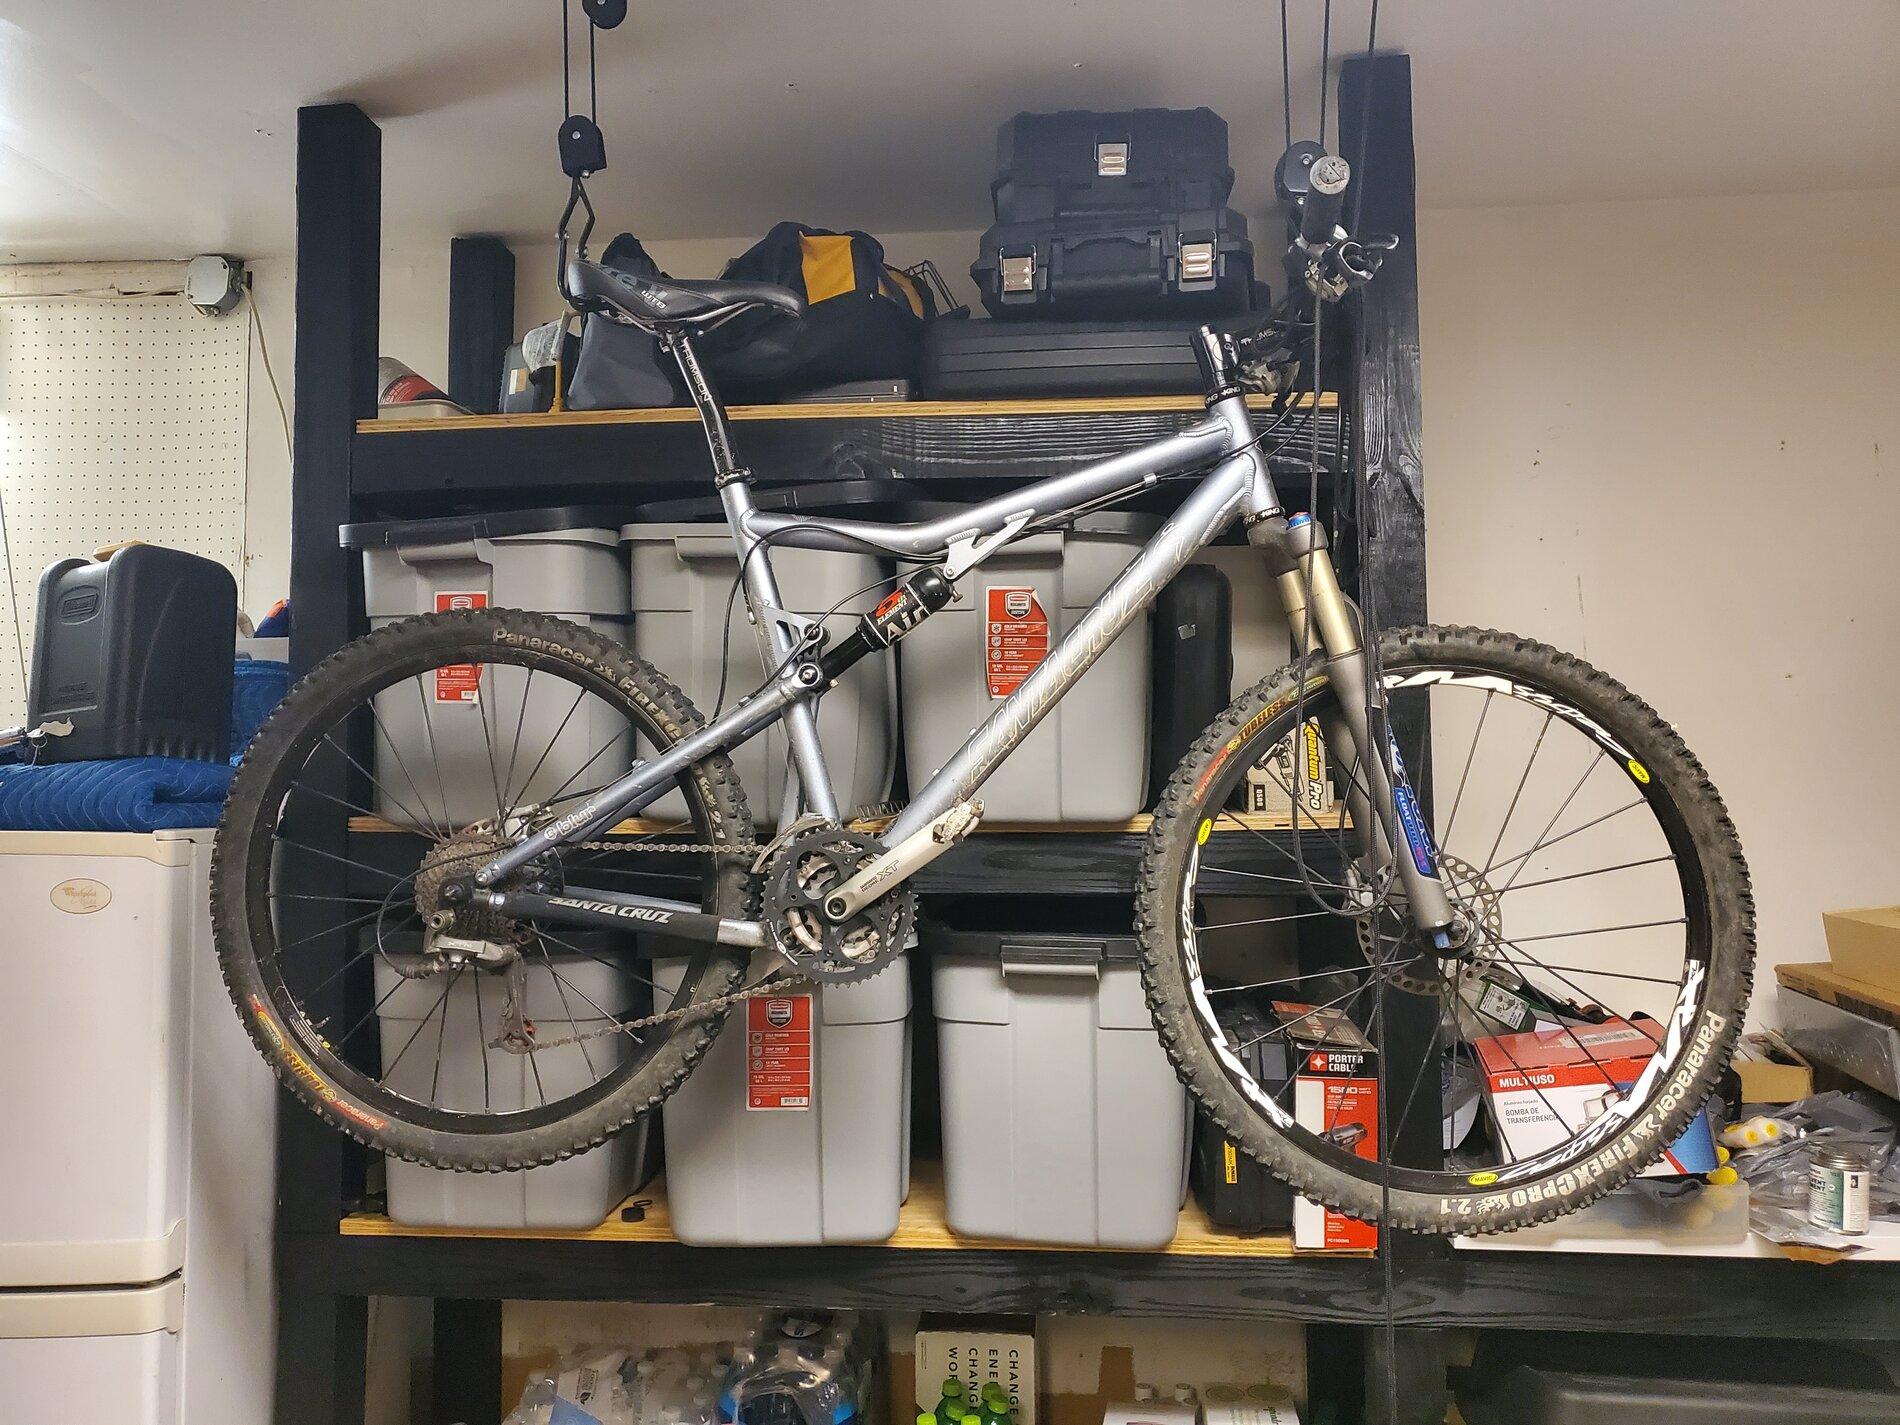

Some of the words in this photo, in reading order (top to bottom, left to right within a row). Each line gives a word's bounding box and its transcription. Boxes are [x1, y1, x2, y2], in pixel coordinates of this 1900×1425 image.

[680, 339, 712, 402] THOMSON
[887, 606, 925, 646] Air
[494, 627, 594, 667] Panaracer
[1239, 697, 1287, 740] TUBELESS
[1194, 750, 1229, 800] Panaracer
[1310, 781, 1323, 810] Pro
[1397, 791, 1412, 821] FLOAT
[556, 804, 597, 836] blur
[877, 860, 900, 882] XT
[548, 898, 618, 916] SANTA
[618, 905, 674, 924] CRUZ
[1661, 1009, 1727, 1122] Panaracer
[337, 1099, 385, 1131] Panaracer
[1505, 1108, 1529, 1117] BOMBA
[1530, 1107, 1540, 1115] DE
[1440, 1197, 1472, 1216] 2.1
[988, 1349, 998, 1384] ENE
[1008, 1349, 1019, 1415] CHANGE
